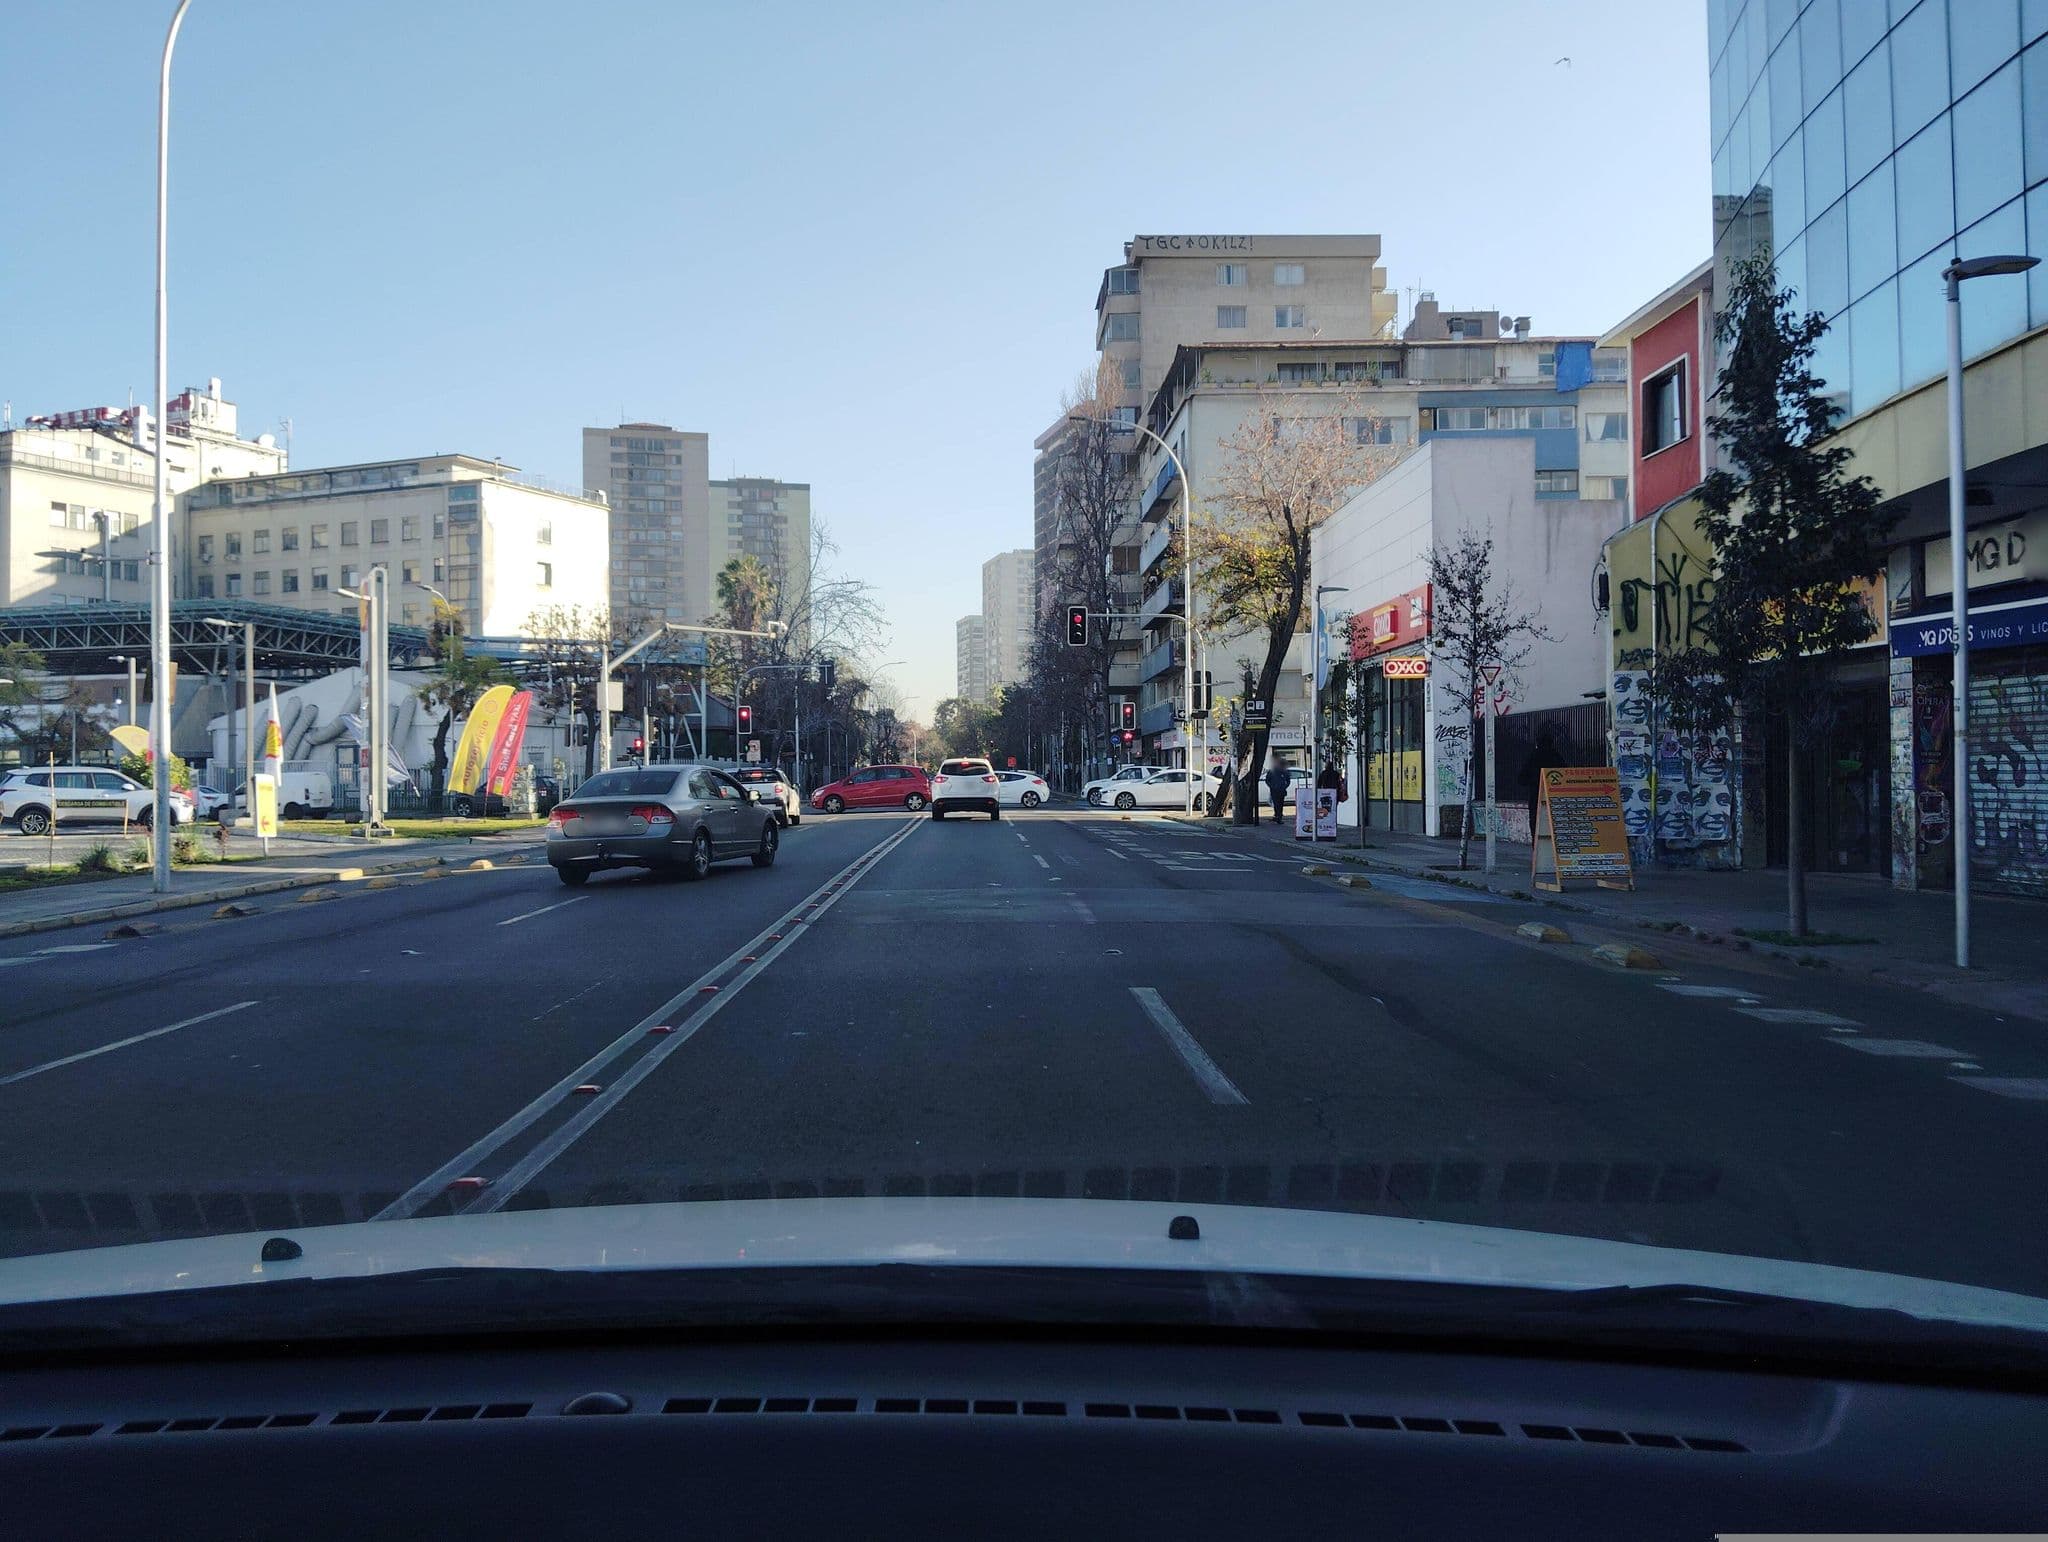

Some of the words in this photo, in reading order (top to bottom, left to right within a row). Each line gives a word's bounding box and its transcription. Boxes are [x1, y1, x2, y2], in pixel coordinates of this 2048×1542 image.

[1138, 235, 1181, 250] TGC
[1373, 612, 1391, 639] OXXO
[1980, 627, 2011, 640] VINOS
[2017, 624, 2024, 636] Y
[1386, 660, 1426, 675] OXXO
[498, 748, 512, 772] Shell
